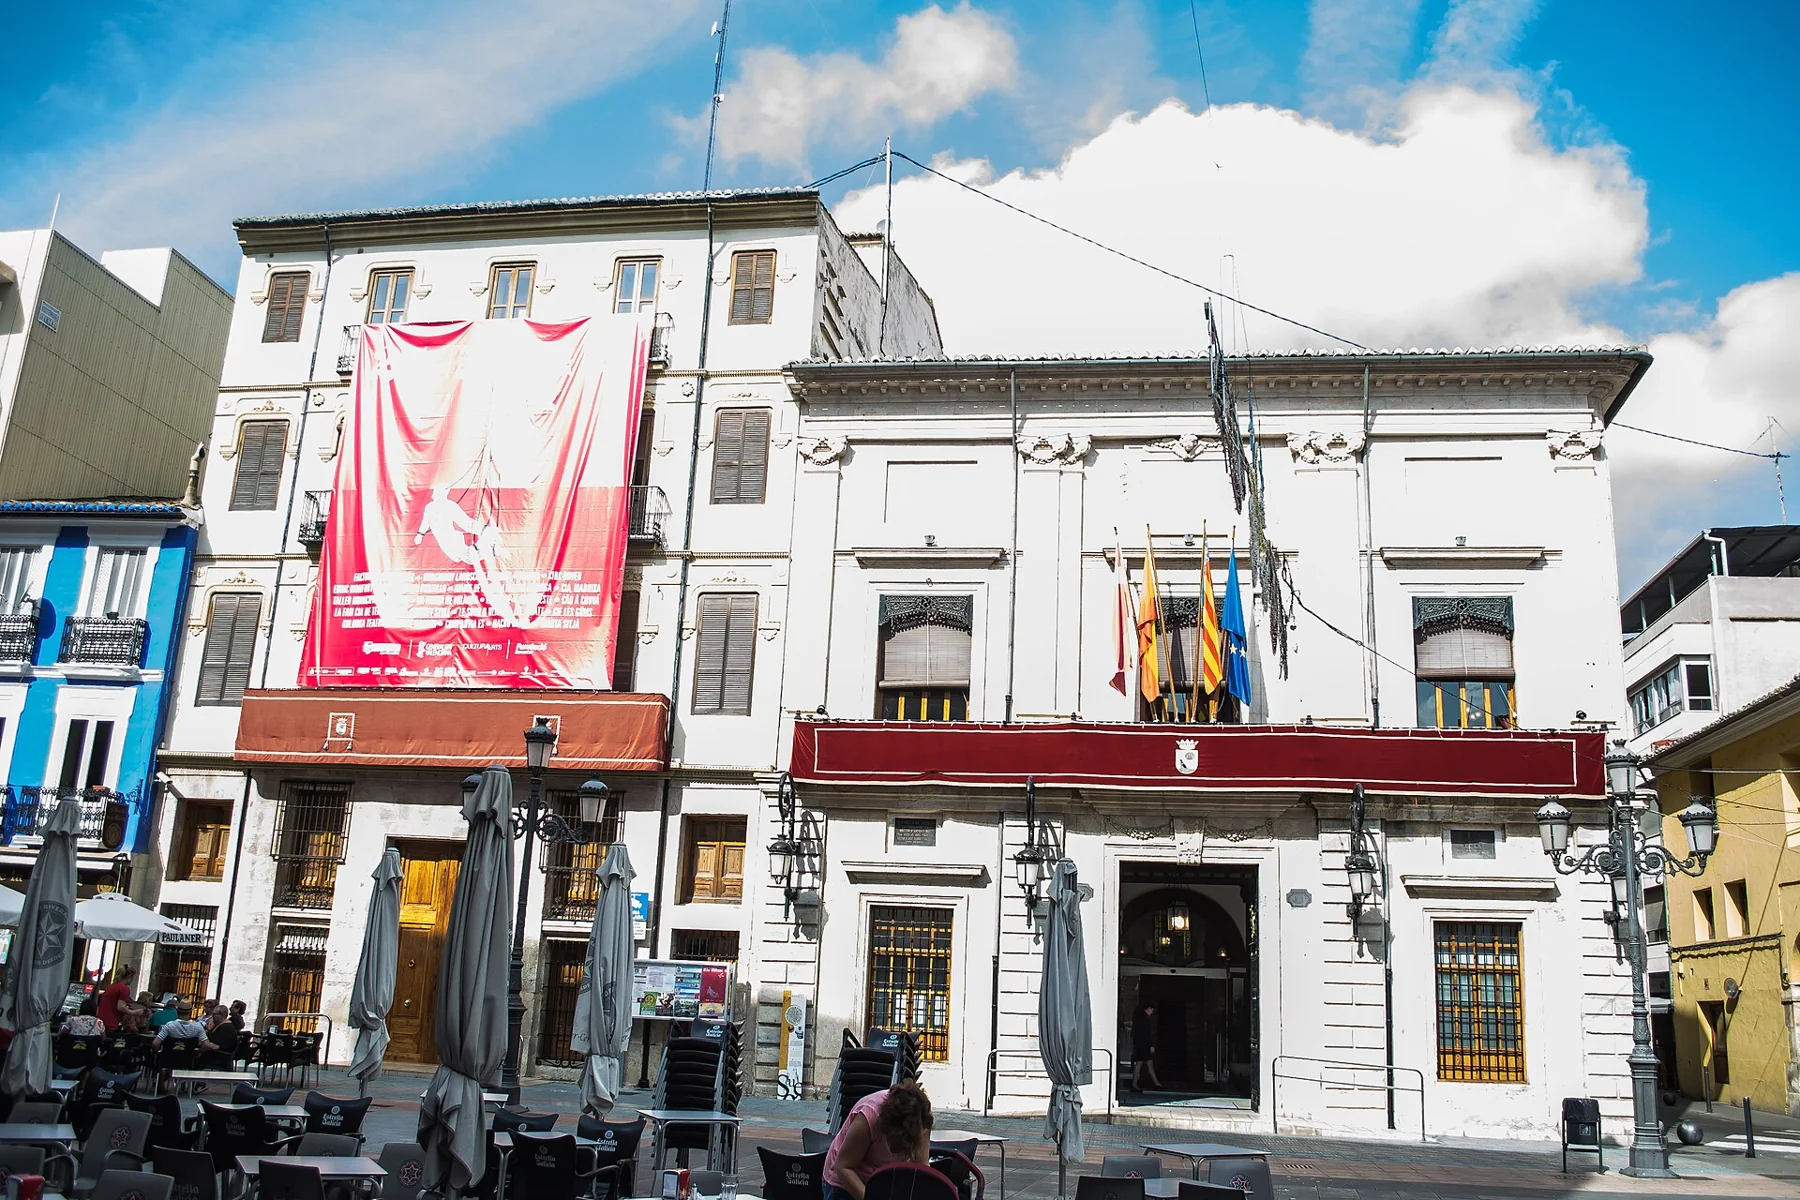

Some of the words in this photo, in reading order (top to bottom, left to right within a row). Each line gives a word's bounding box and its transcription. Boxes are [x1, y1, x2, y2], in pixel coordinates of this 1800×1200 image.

[43, 904, 68, 918] RIVERA
[162, 932, 202, 944] PAULANER
[322, 1112, 344, 1122] Estrella
[321, 1119, 341, 1127] Galicia
[596, 1138, 618, 1147] Estrella
[534, 1153, 556, 1162] Estrella
[536, 1160, 556, 1168] Galicia
[785, 1171, 810, 1180] Estrella
[786, 1178, 809, 1186] Galicia
[173, 1183, 199, 1194] trella
